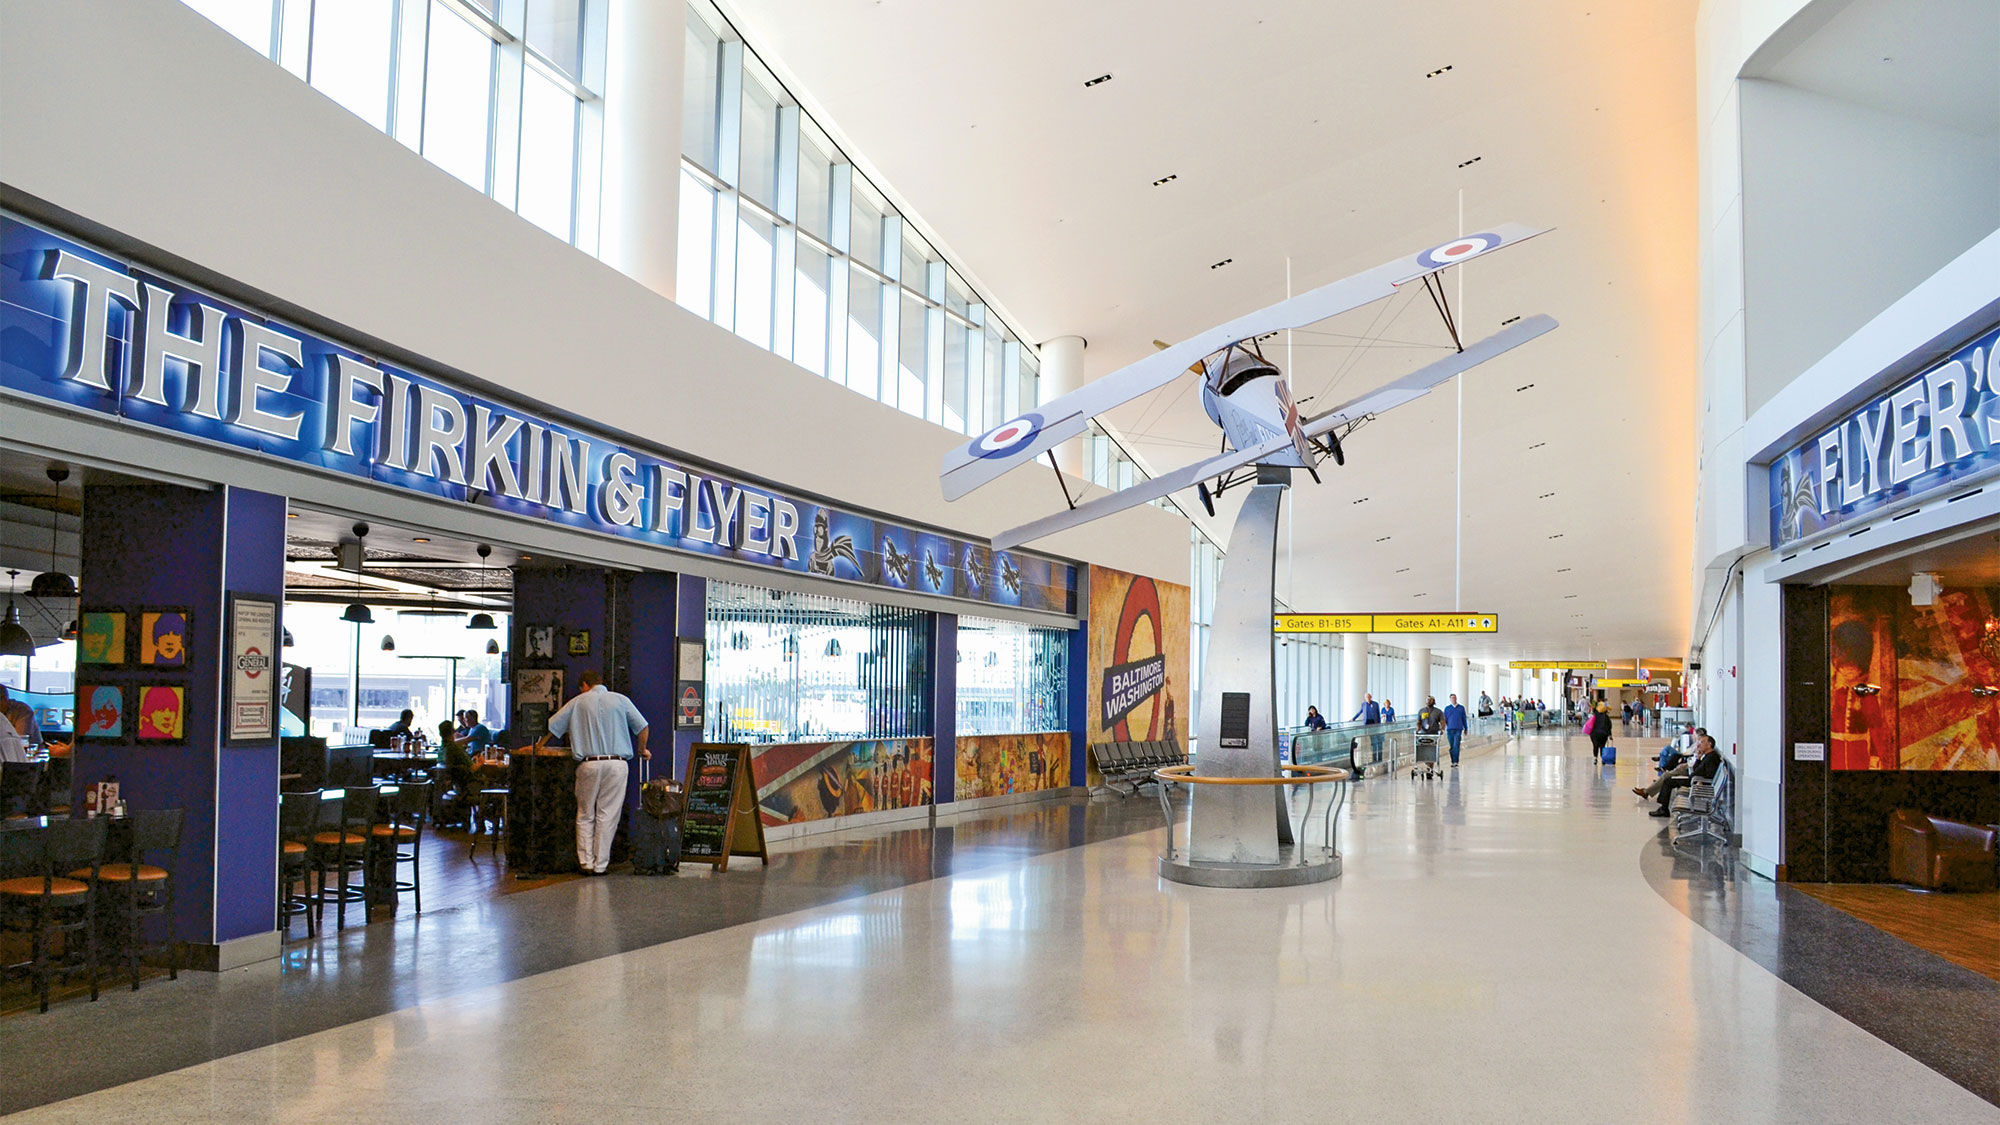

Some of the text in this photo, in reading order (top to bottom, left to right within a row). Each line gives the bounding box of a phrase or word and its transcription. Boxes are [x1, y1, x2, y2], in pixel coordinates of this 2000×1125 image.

[44, 248, 799, 562] THE FIRKIN & FLYER
[1286, 618, 1352, 629] Gates B1-B15
[1395, 618, 1465, 629] Gates A1-A11
[238, 655, 268, 669] GENERAL
[1112, 660, 1162, 695] BALTIMORE
[1105, 672, 1164, 720] WASHINGTON
